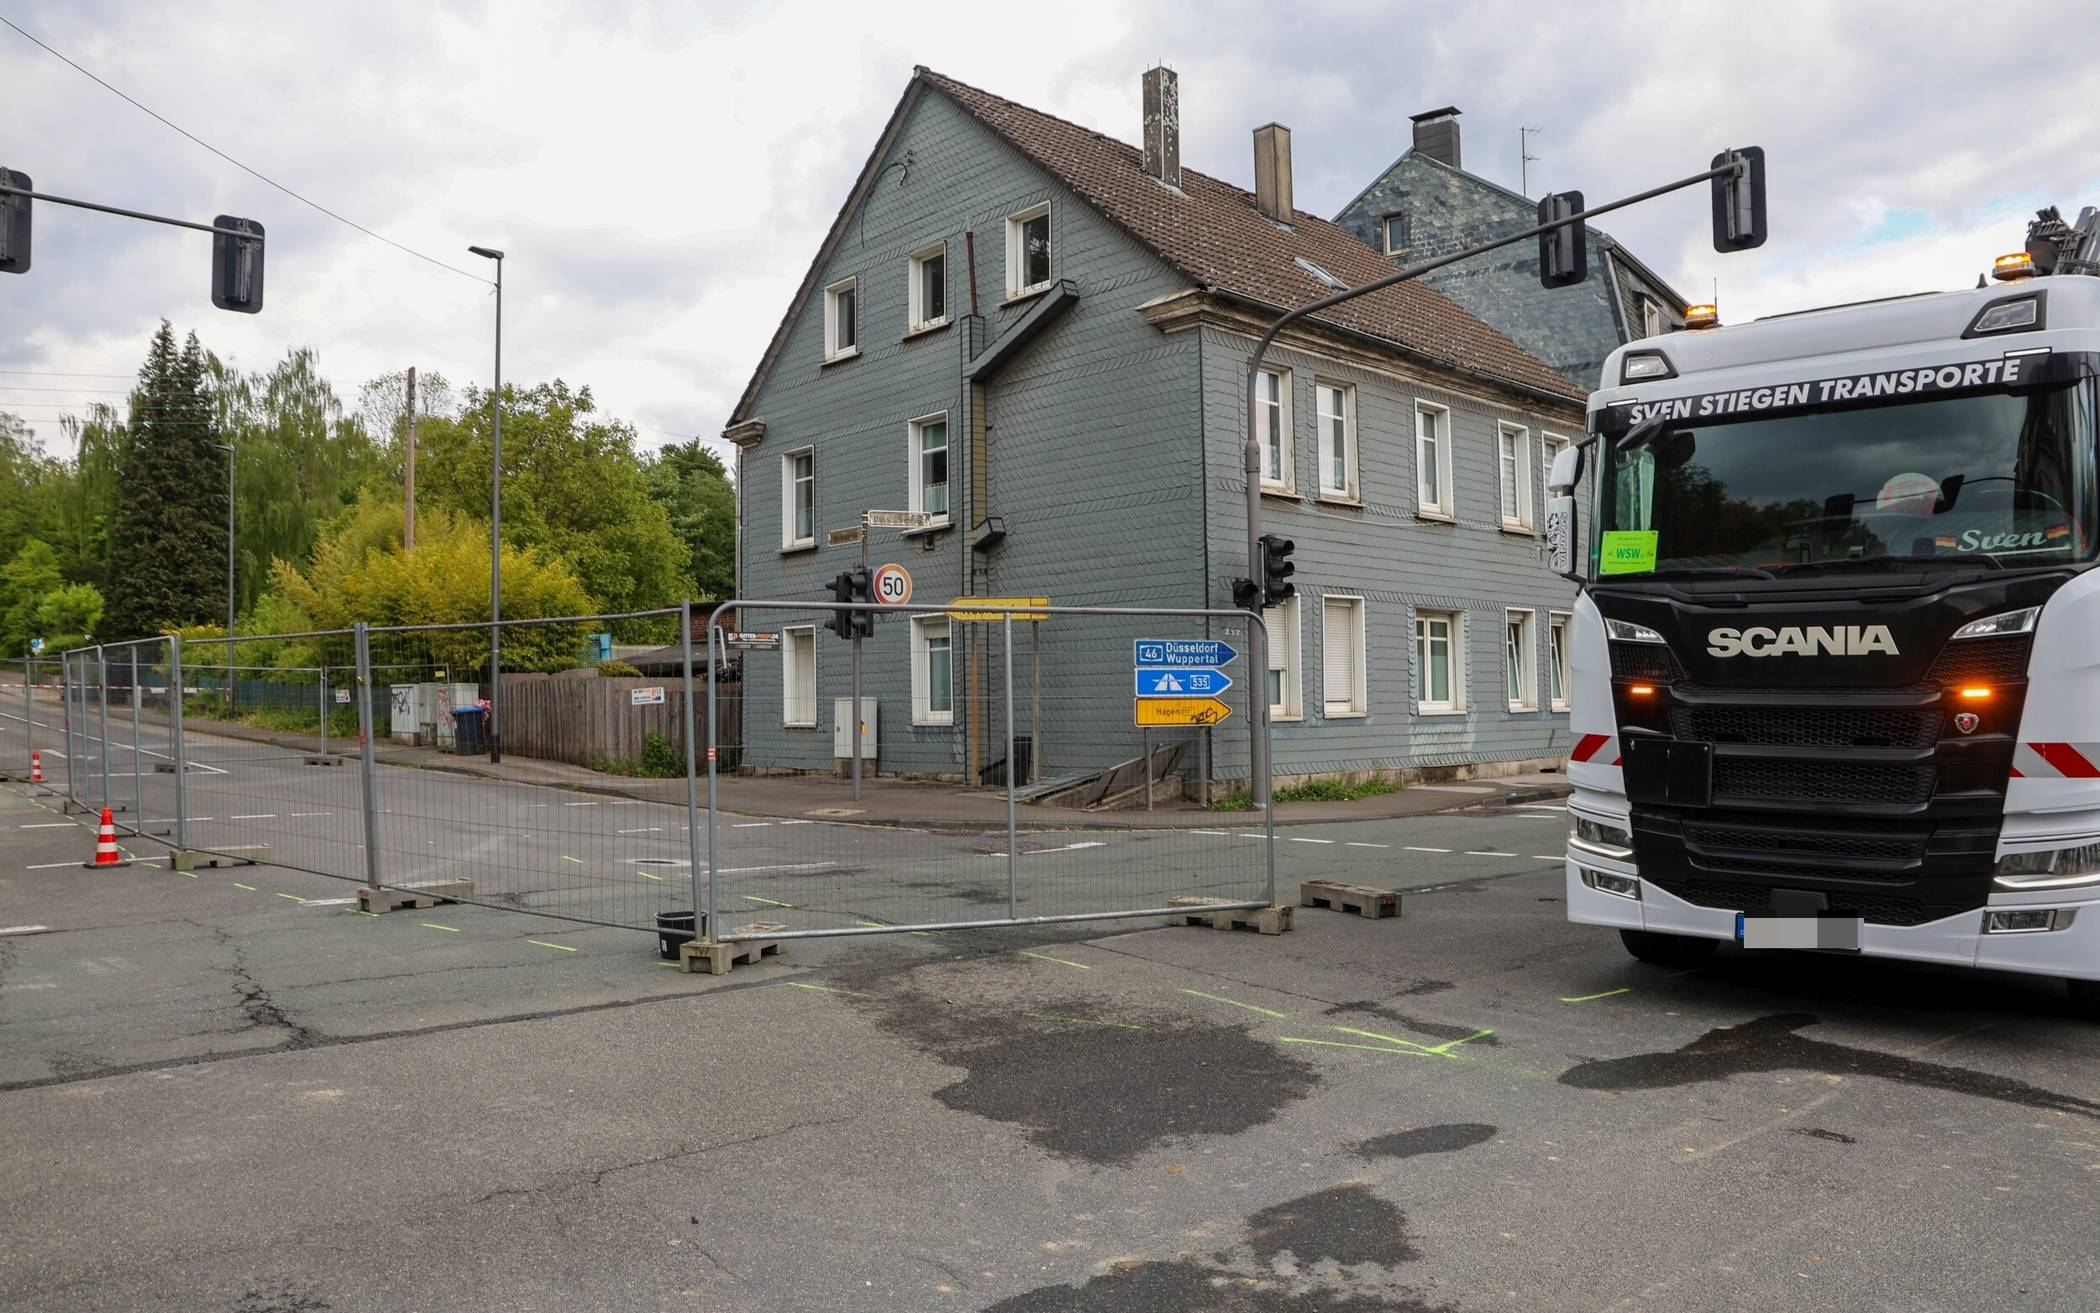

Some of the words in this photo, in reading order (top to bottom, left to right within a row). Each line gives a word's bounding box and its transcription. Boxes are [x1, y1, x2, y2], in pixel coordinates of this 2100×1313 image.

[1629, 398, 1692, 424] SVEN
[1699, 383, 1809, 416] STIEGEN
[1819, 359, 2021, 401] TRANSPORTE
[1957, 529, 2047, 552] Sven
[1616, 548, 1641, 559] WSW
[883, 577, 904, 596] 50
[1707, 625, 1900, 658] SCANIA
[1166, 642, 1218, 653] Düsseldorf
[1145, 649, 1157, 659] 46
[1166, 653, 1218, 665] Wuppertal
[1192, 679, 1208, 687] 535
[1156, 707, 1180, 717] Hagen
